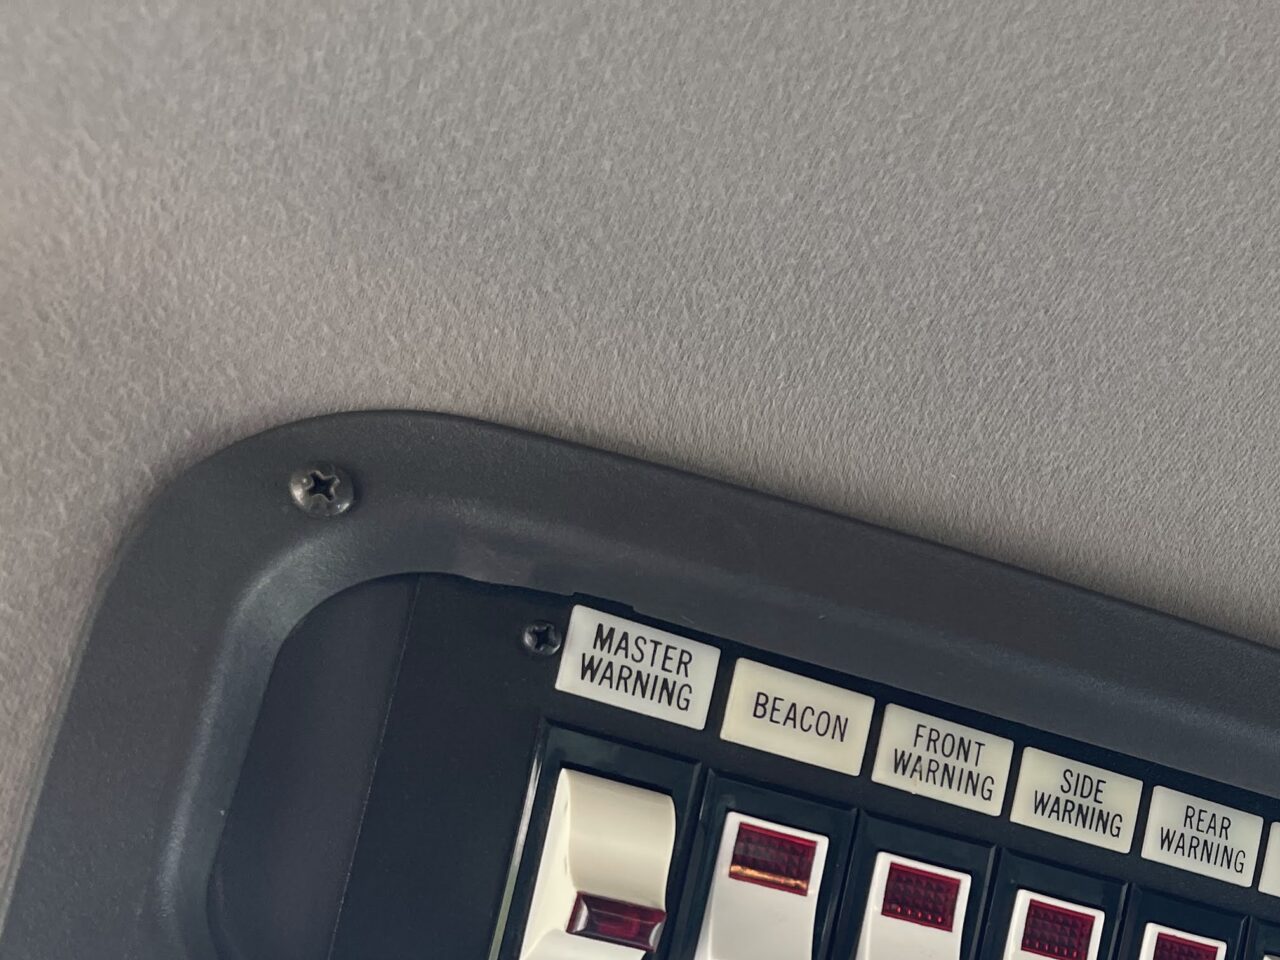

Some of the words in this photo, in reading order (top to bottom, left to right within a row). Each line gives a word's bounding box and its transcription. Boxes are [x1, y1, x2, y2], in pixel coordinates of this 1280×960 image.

[593, 623, 693, 678] MASTER
[580, 652, 693, 712] WARNING
[753, 692, 849, 743] BEACON
[913, 724, 986, 767] FRONT
[893, 749, 995, 802] WARNING
[1060, 769, 1107, 804] SIDE
[1034, 790, 1123, 838] WARNING
[1183, 805, 1232, 840] REAR
[1160, 827, 1246, 874] WARNING
